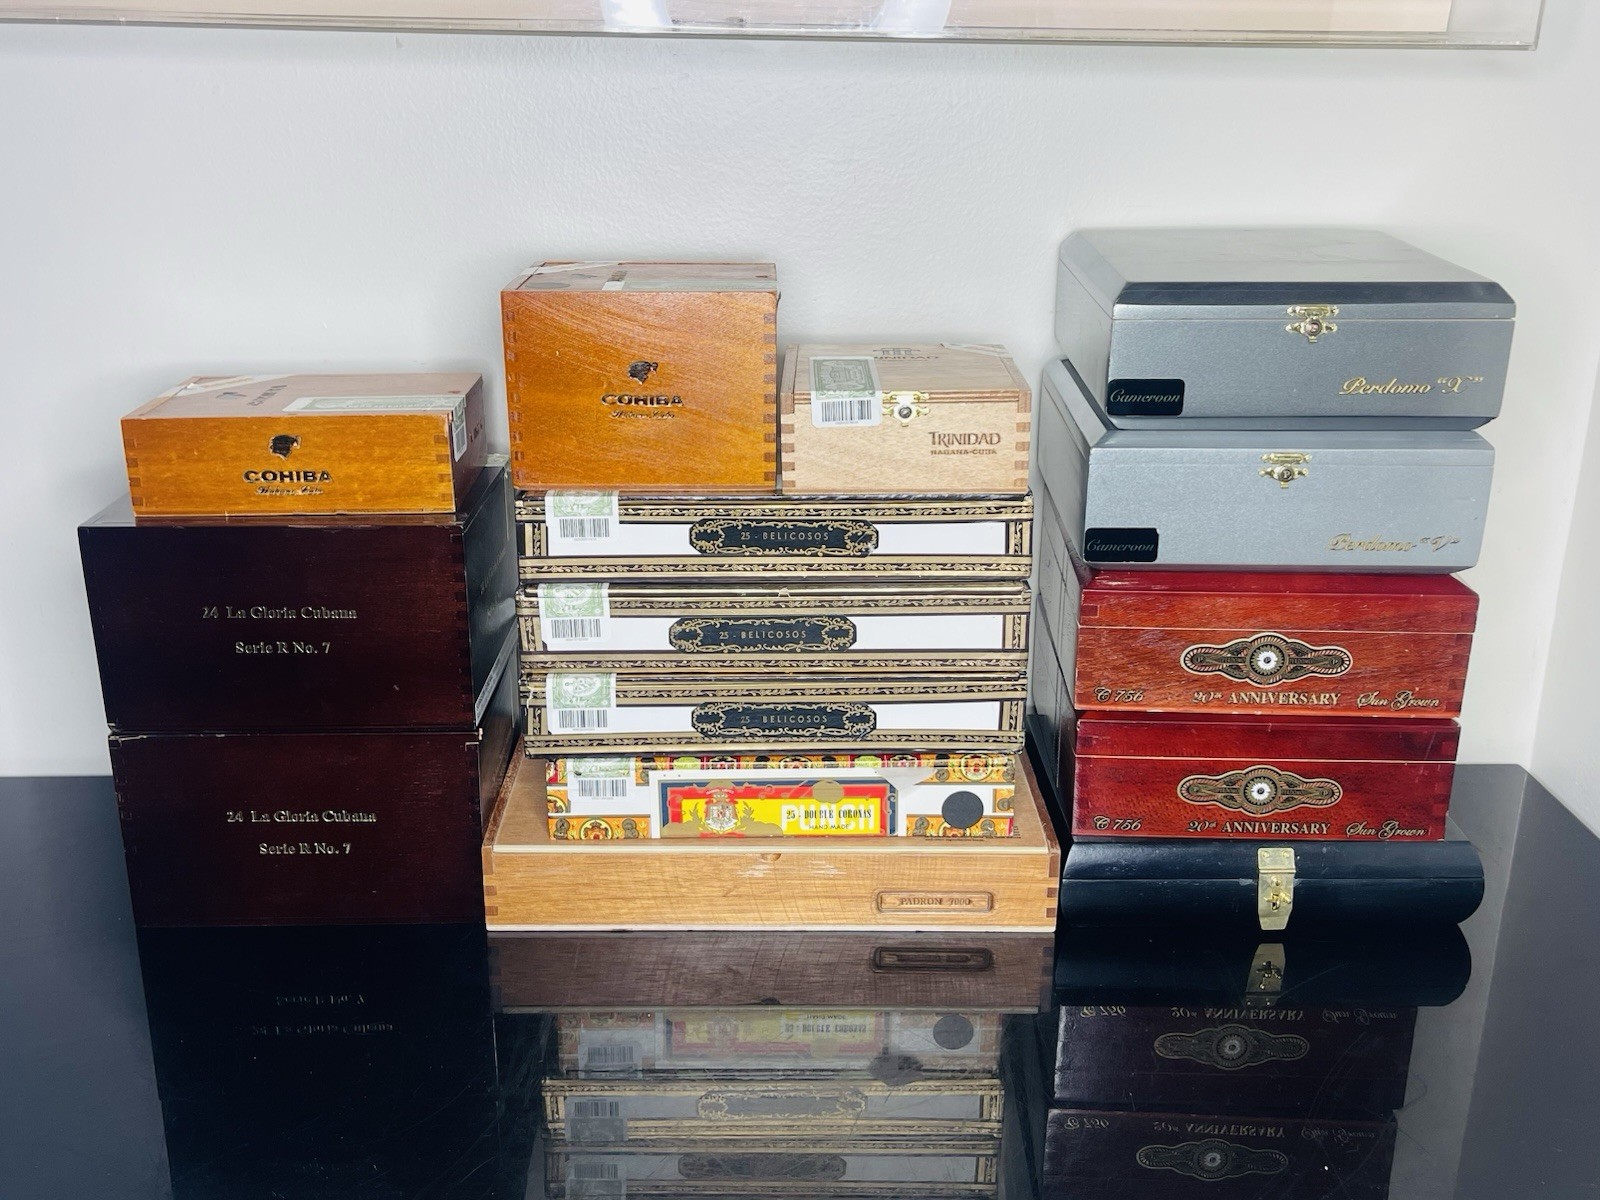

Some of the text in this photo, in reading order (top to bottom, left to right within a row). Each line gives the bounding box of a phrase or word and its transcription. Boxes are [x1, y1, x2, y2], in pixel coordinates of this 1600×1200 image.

[1339, 376, 1431, 395] Perdomo
[601, 393, 684, 407] COHIBA
[1110, 388, 1181, 403] Cameroon
[928, 431, 1001, 448] TRINIDAD
[243, 469, 334, 483] COHIBA
[740, 531, 751, 541] 25
[762, 531, 829, 541] BELICOSOS
[1328, 533, 1417, 552] Perdomo
[1087, 538, 1155, 552] Cameroon
[202, 605, 358, 619] 24 La Gloria Cubana
[718, 631, 729, 640] 25
[741, 630, 807, 639] BELICOSOS
[235, 641, 331, 654] Serie R No. 7
[1094, 687, 1144, 703] C 756
[1227, 691, 1341, 705] ANNIVERSARY
[1357, 689, 1440, 711] Sun Grown
[740, 714, 828, 725] 25 BELICOSOS
[226, 809, 377, 823] 24 La Gloria Cubana
[781, 803, 875, 831] PUNCH
[786, 810, 796, 819] 25
[804, 809, 834, 819] DOUBLE
[838, 809, 872, 819] CORONAS
[1093, 815, 1142, 831] C 756
[1221, 821, 1331, 835] ANNIVERSARY
[1346, 820, 1427, 839] Sun Grown
[259, 842, 351, 855] Serie R No. 7
[900, 897, 943, 906] PADRON
